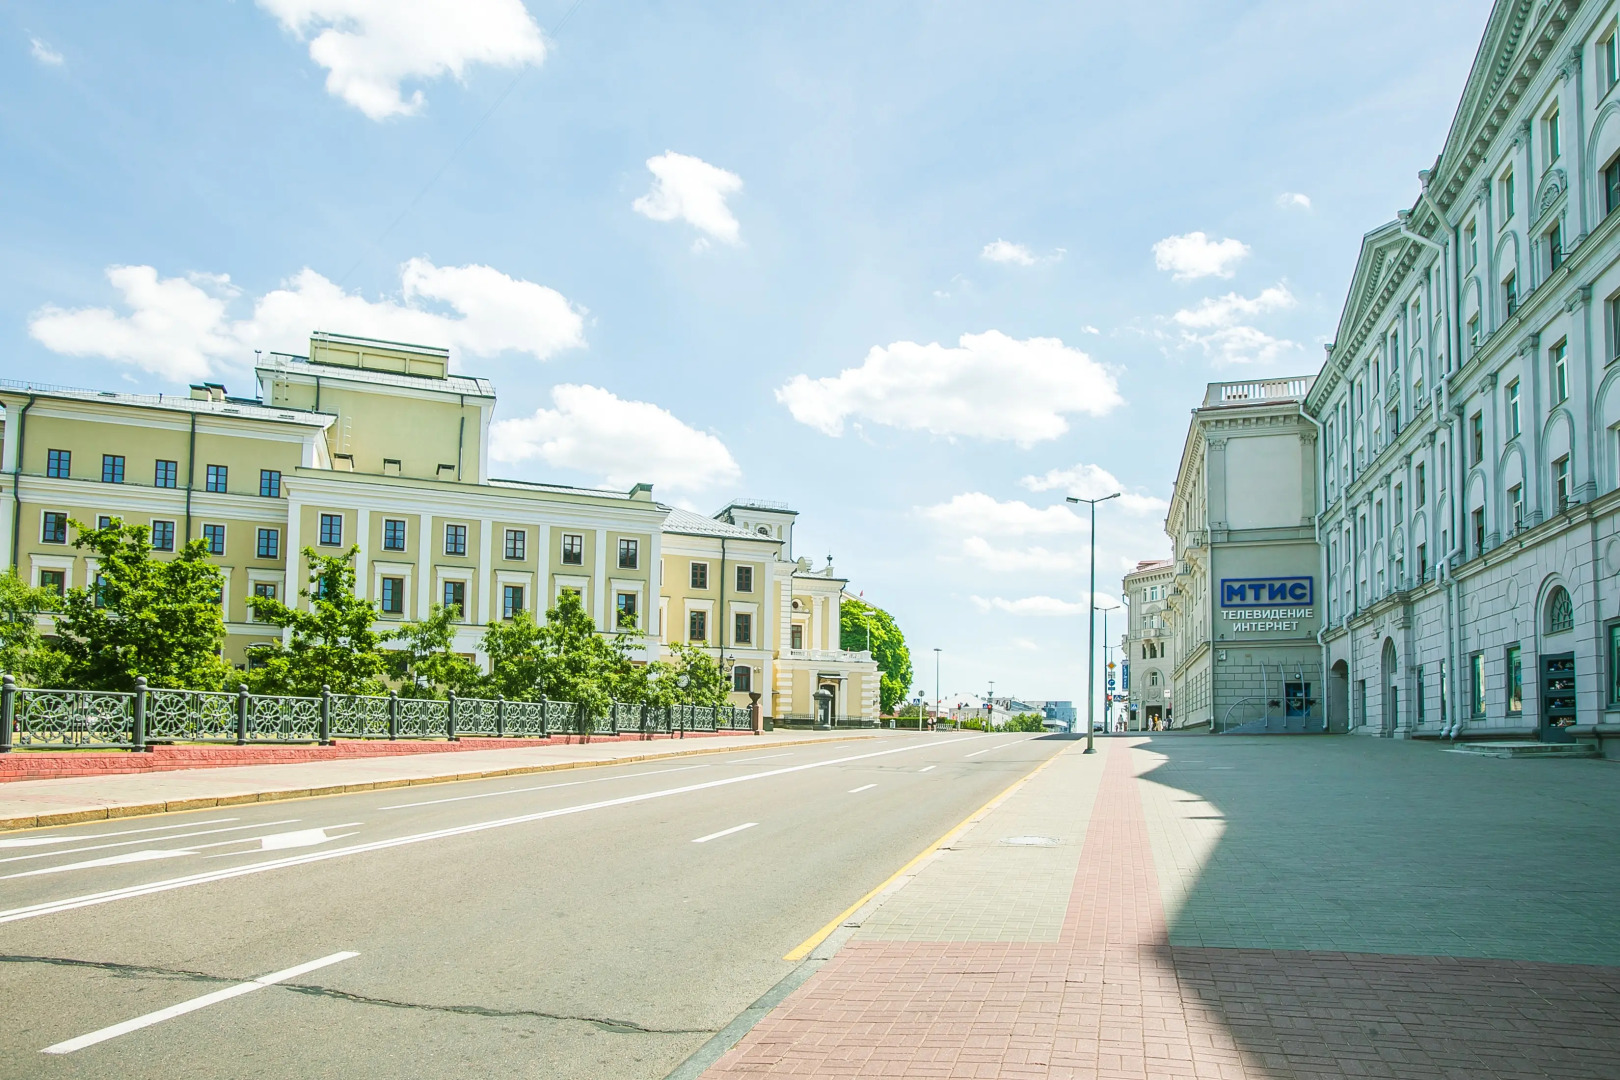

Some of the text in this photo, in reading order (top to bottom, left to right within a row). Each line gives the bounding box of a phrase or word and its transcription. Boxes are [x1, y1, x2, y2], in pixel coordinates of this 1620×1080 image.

[1226, 583, 1308, 601] МТИС
[1221, 608, 1313, 620] ТЕЛЕВИДЕНИЕ
[1233, 621, 1298, 632] ИНТЕРНЕТ
